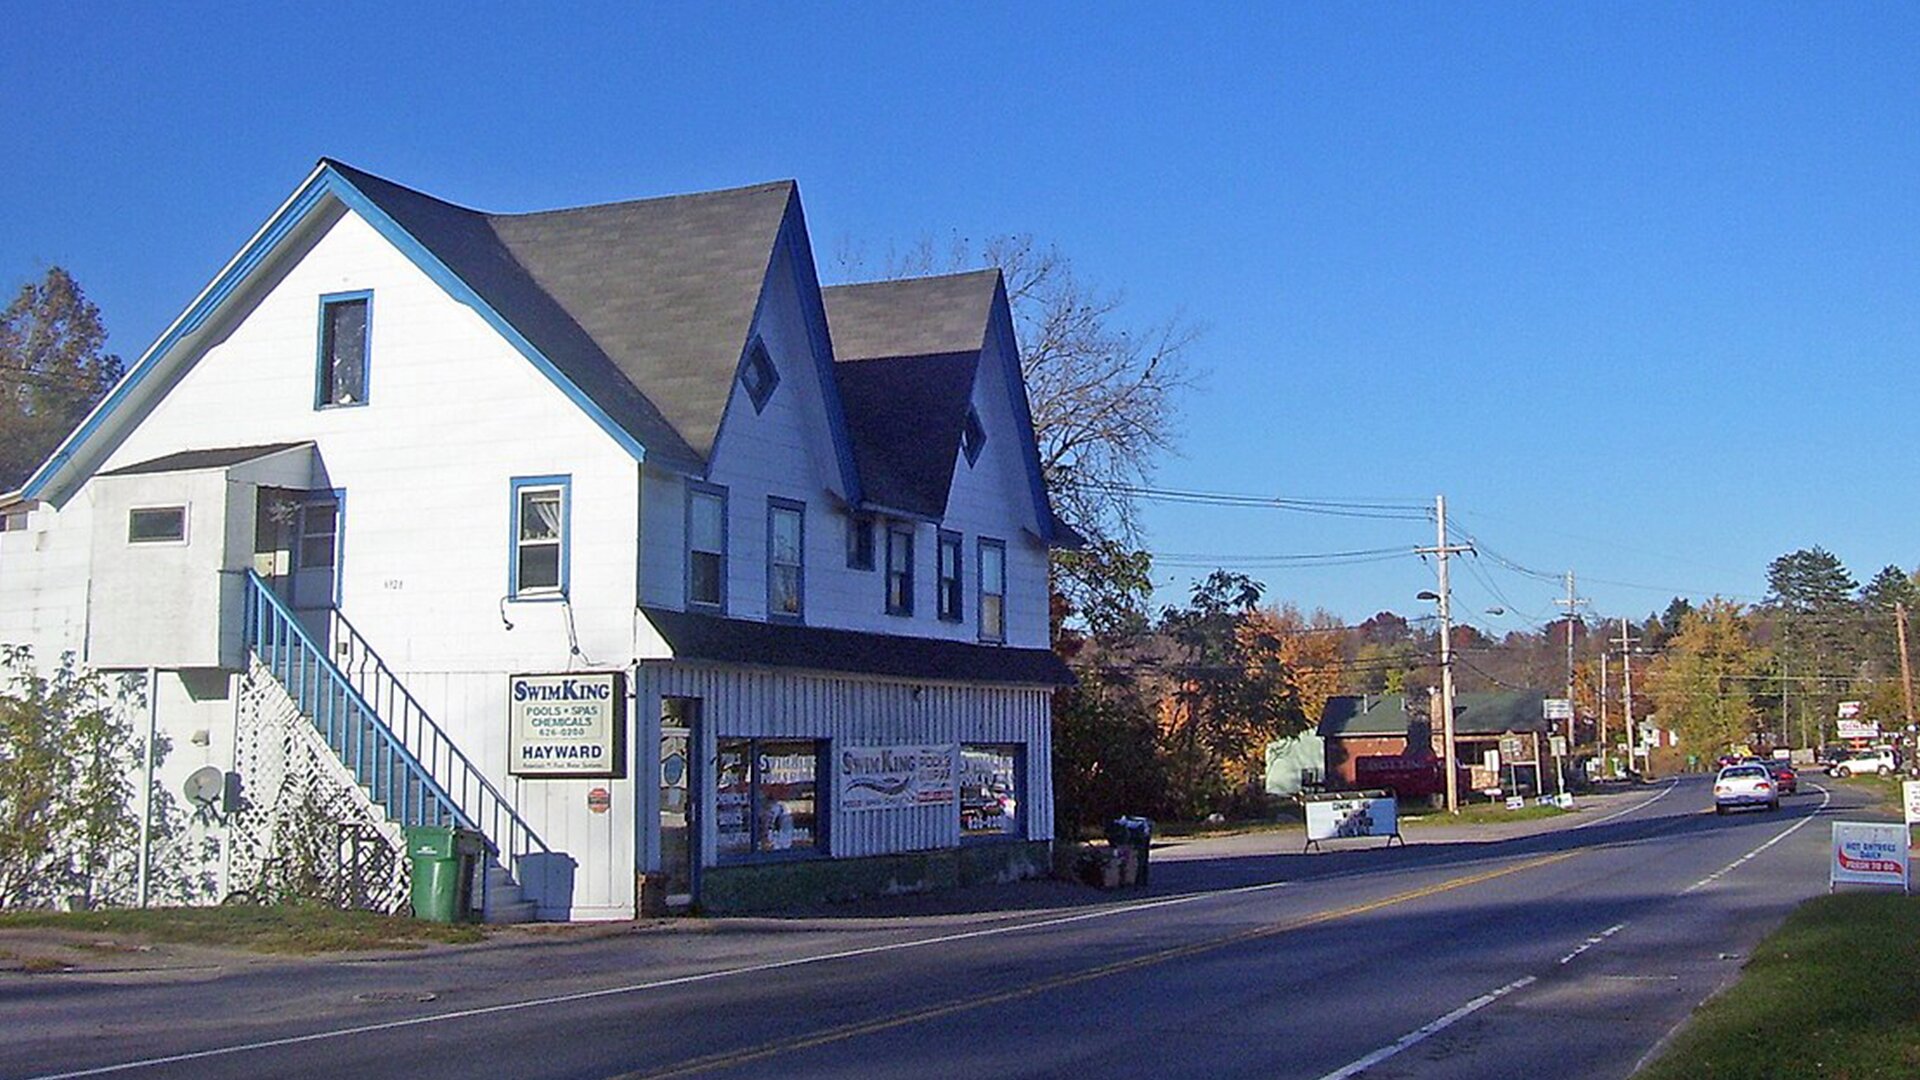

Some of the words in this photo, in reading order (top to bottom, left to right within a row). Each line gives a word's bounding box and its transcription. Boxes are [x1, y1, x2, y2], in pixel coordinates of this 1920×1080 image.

[526, 706, 561, 716] POOLS
[571, 705, 598, 716] SPAS
[531, 717, 592, 727] CHEMICALS
[522, 745, 602, 759] HAYWARD
